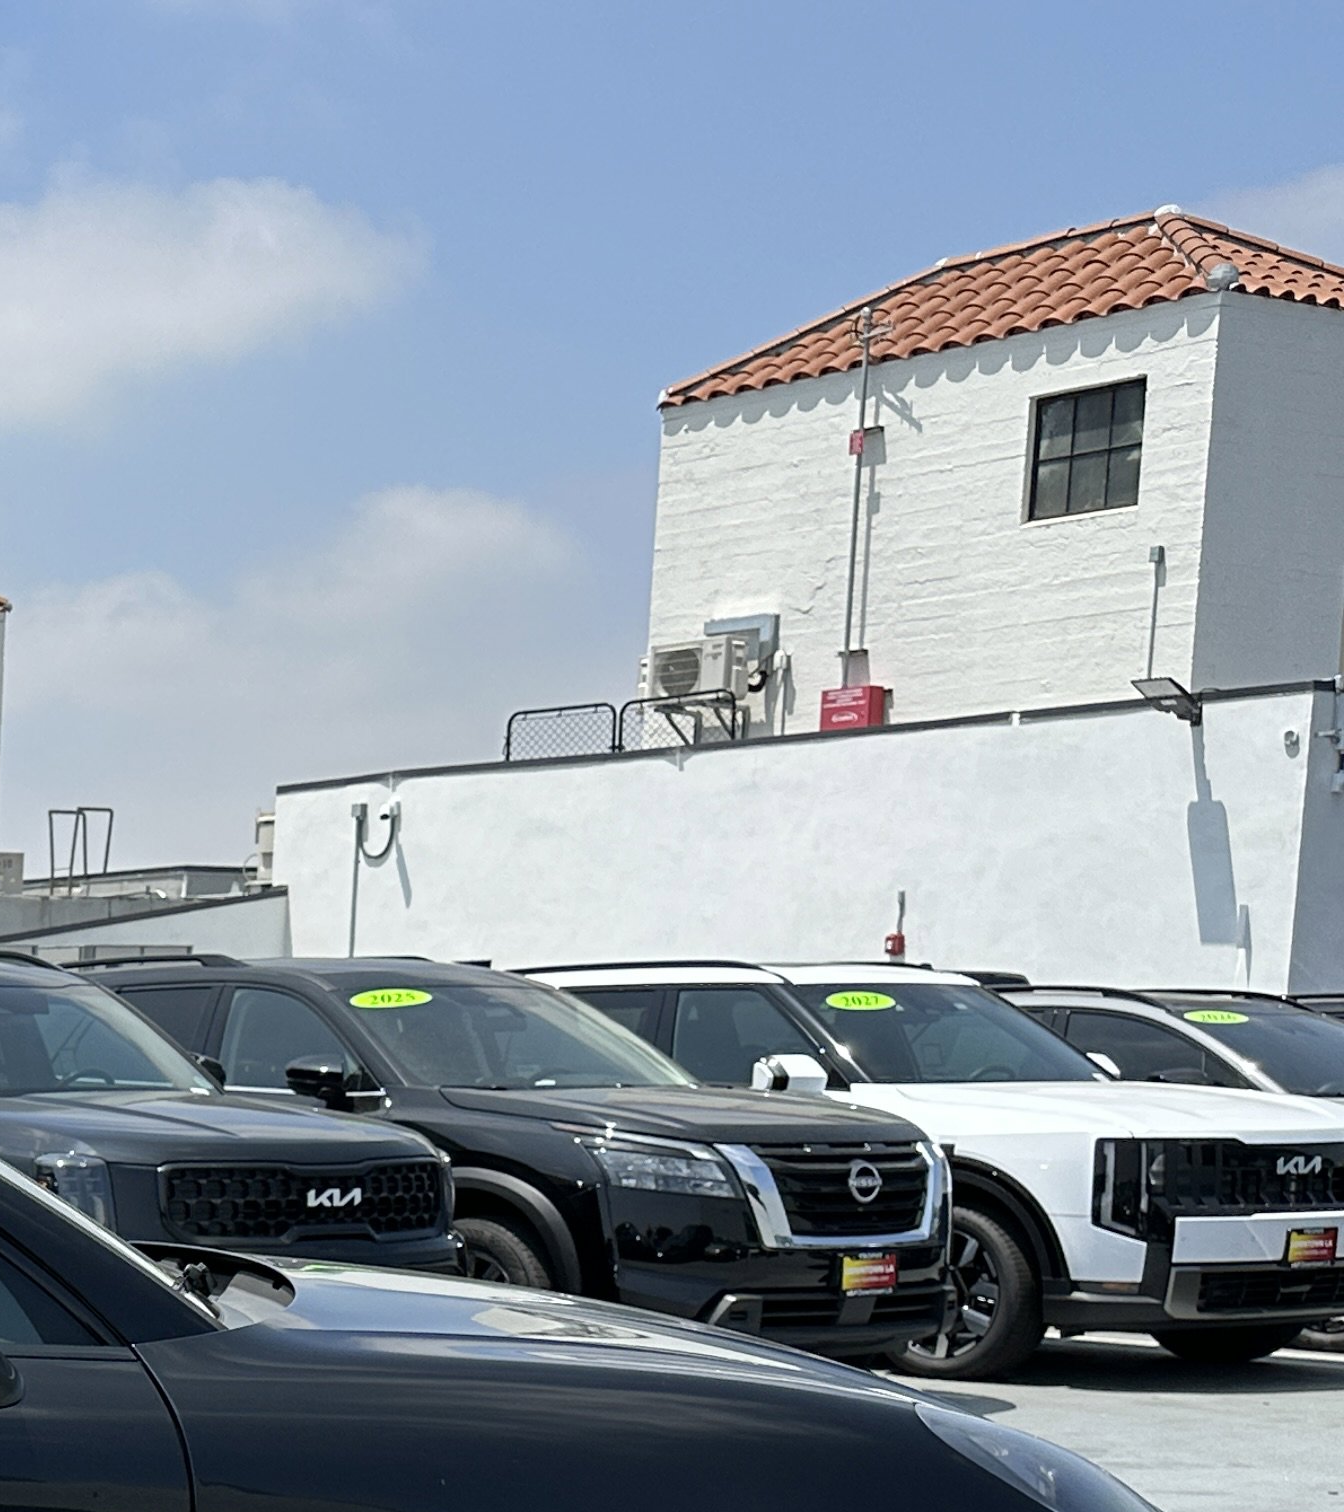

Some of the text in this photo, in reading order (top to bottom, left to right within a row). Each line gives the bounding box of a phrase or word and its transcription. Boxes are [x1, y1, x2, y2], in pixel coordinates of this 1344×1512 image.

[1275, 1155, 1322, 1175] KIA
[848, 1177, 883, 1188] NISSAN
[306, 1187, 362, 1207] KIA
